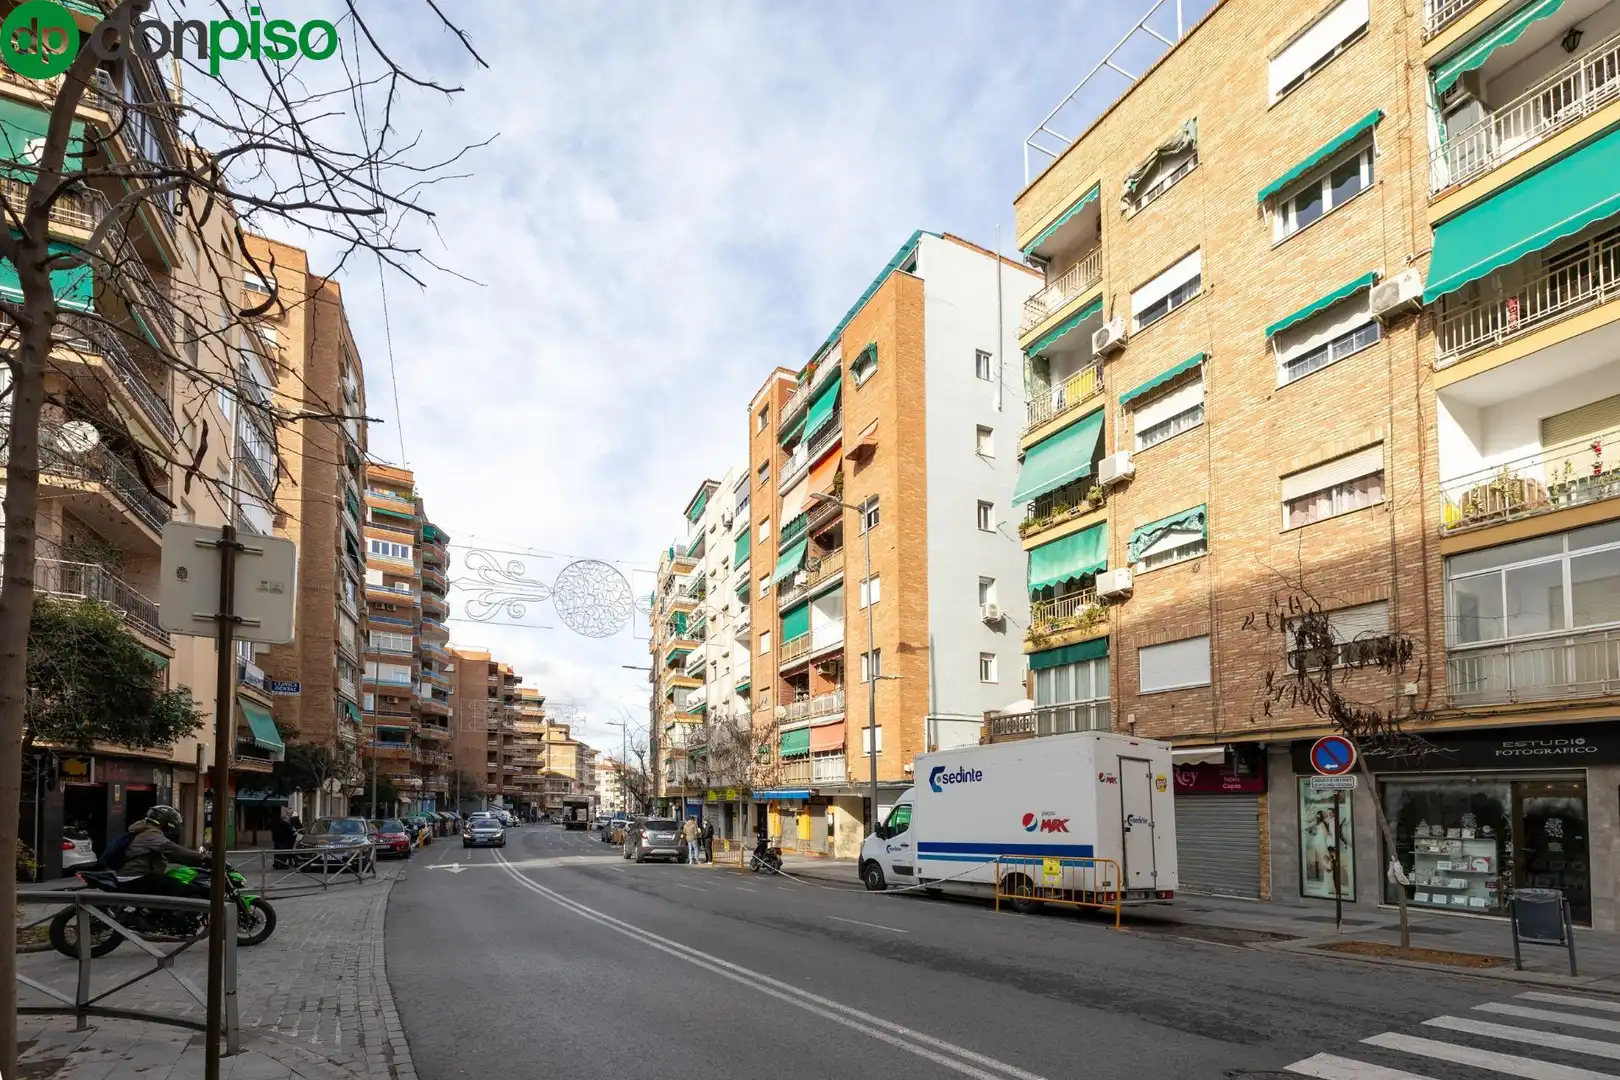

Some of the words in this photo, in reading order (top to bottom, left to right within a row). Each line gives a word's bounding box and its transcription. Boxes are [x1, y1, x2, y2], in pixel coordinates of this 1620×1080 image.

[1502, 738, 1586, 748] ESTUDIO
[1495, 746, 1598, 756] FOTOGRAFICO
[942, 765, 983, 784] sedinte
[1222, 783, 1242, 791] Copas
